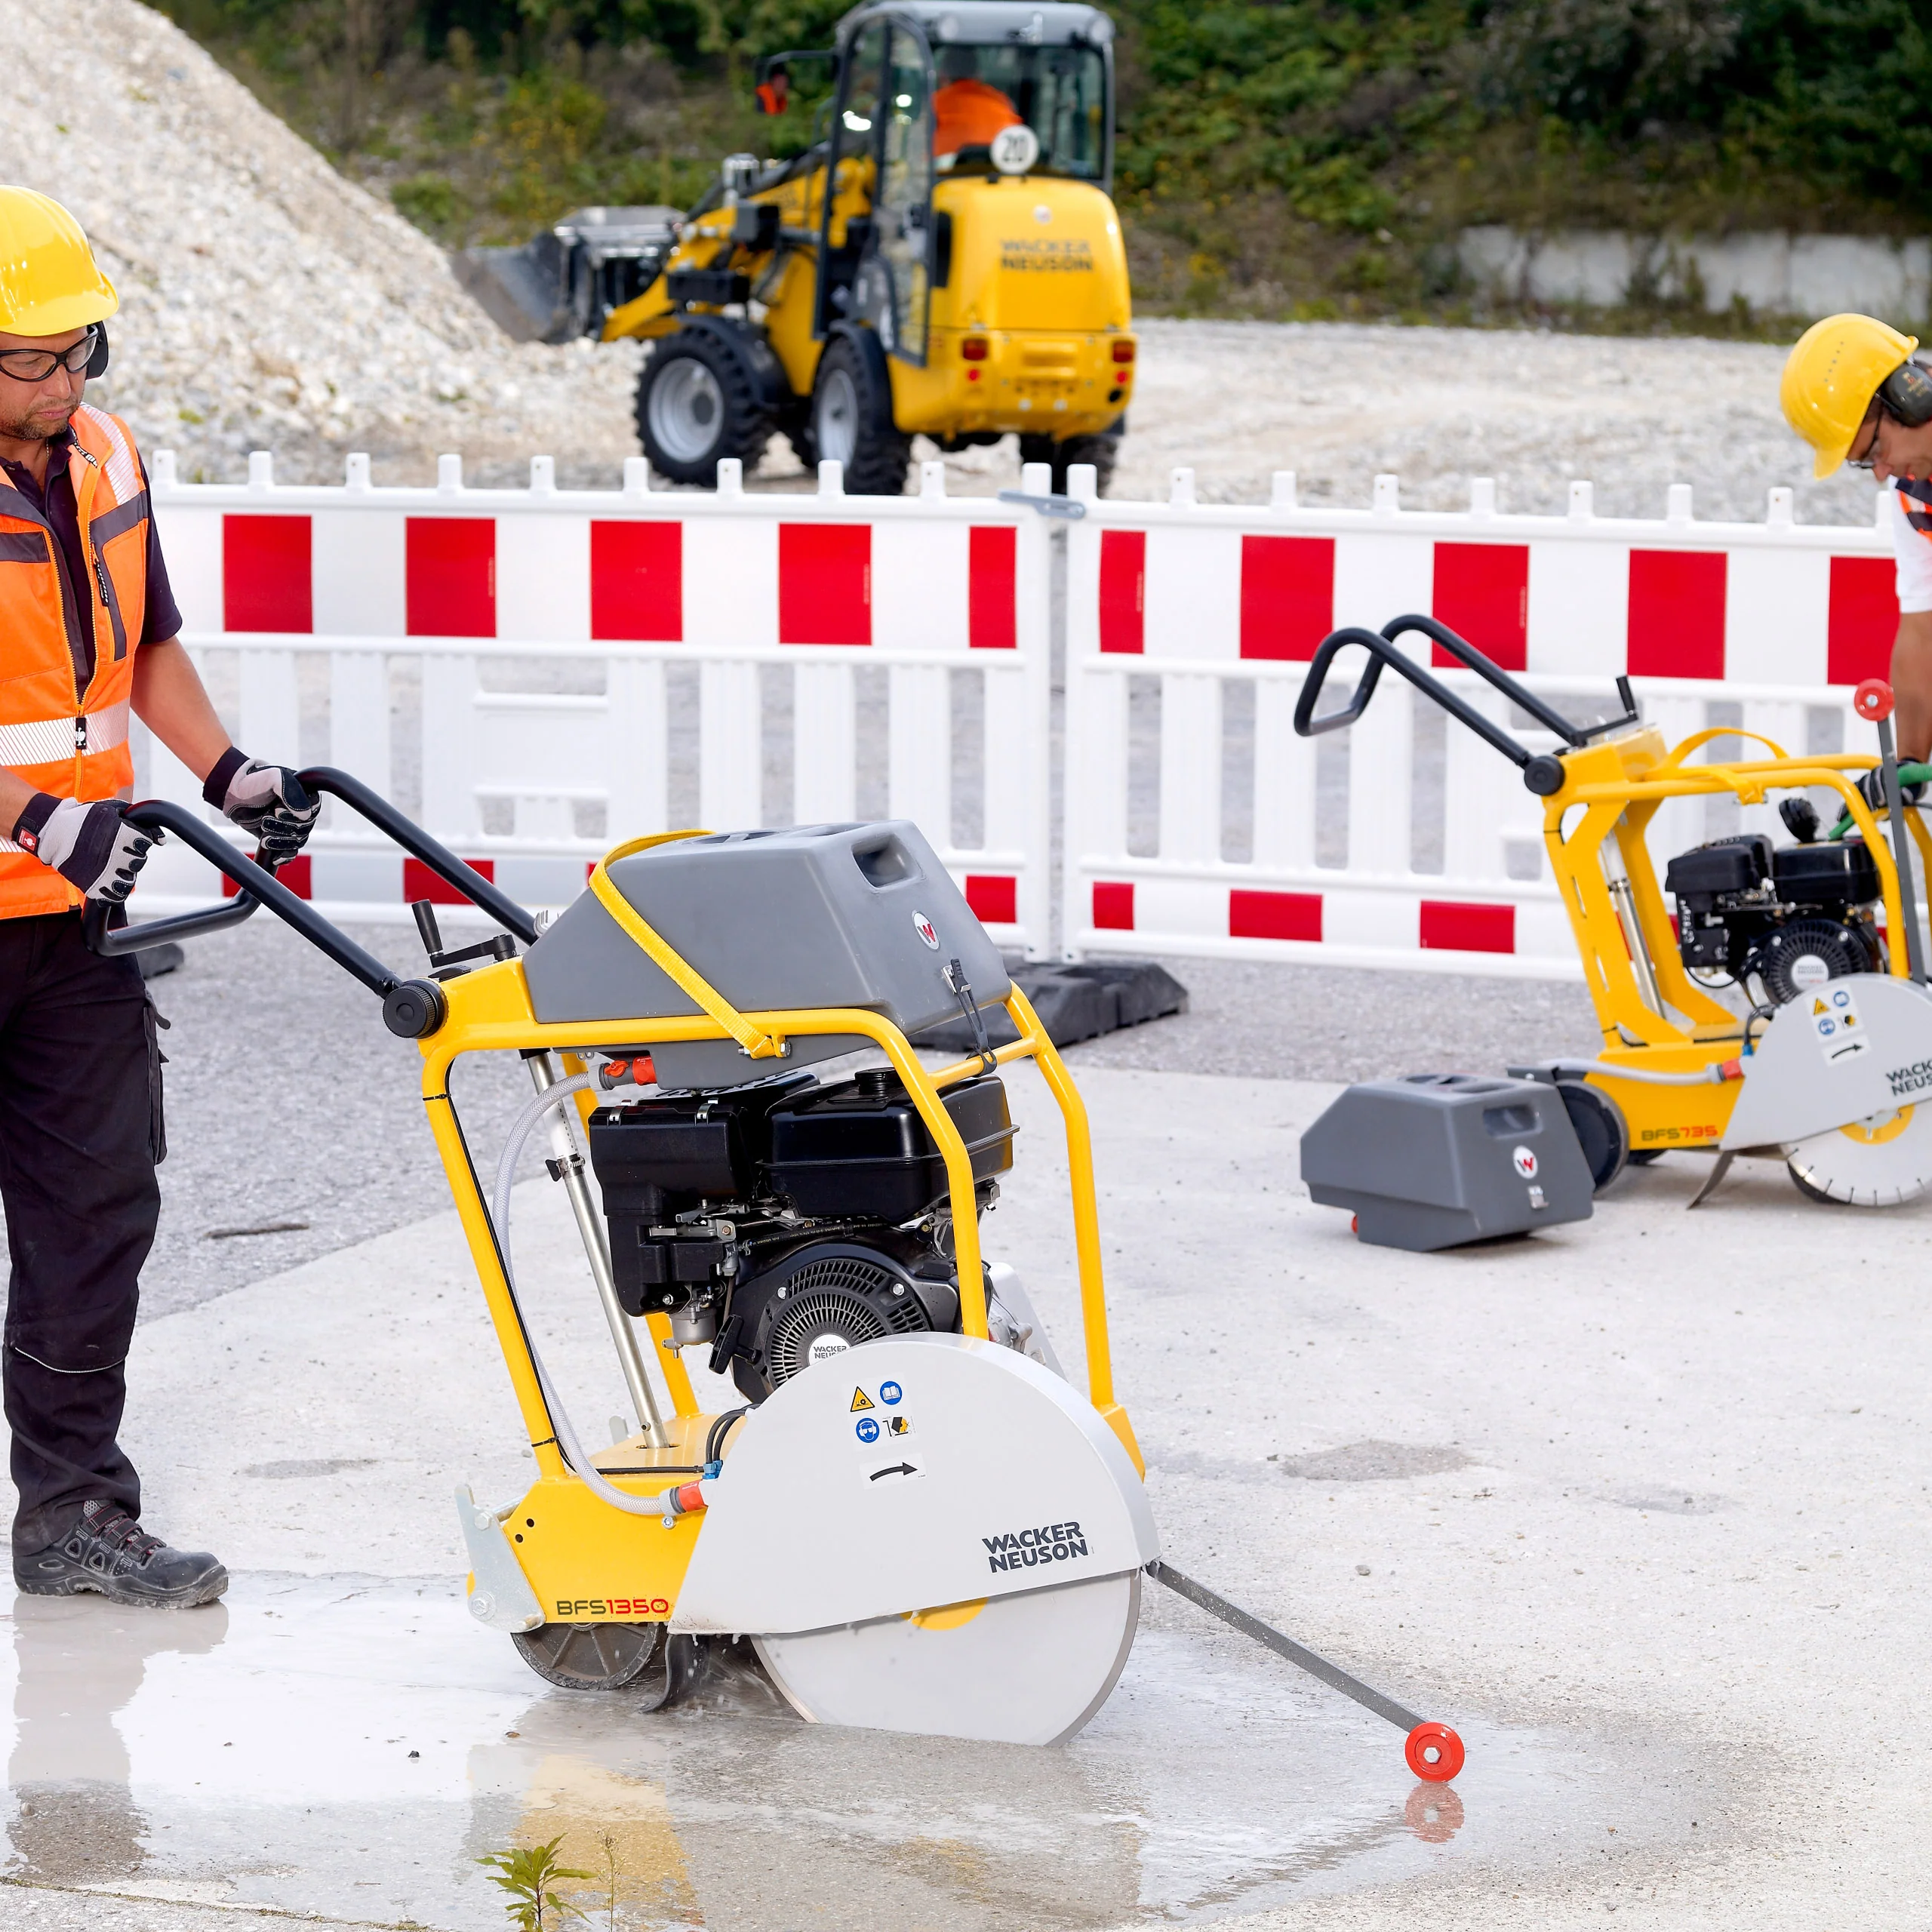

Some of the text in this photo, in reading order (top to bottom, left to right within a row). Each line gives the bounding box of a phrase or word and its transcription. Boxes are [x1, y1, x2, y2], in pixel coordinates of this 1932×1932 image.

[1001, 134, 1028, 162] 20
[1001, 255, 1093, 272] NEUSON
[1641, 1124, 1718, 1141] BFS735
[981, 1521, 1084, 1555] WACKER
[988, 1539, 1088, 1574] NEUSON
[556, 1598, 669, 1616] BFS1350
